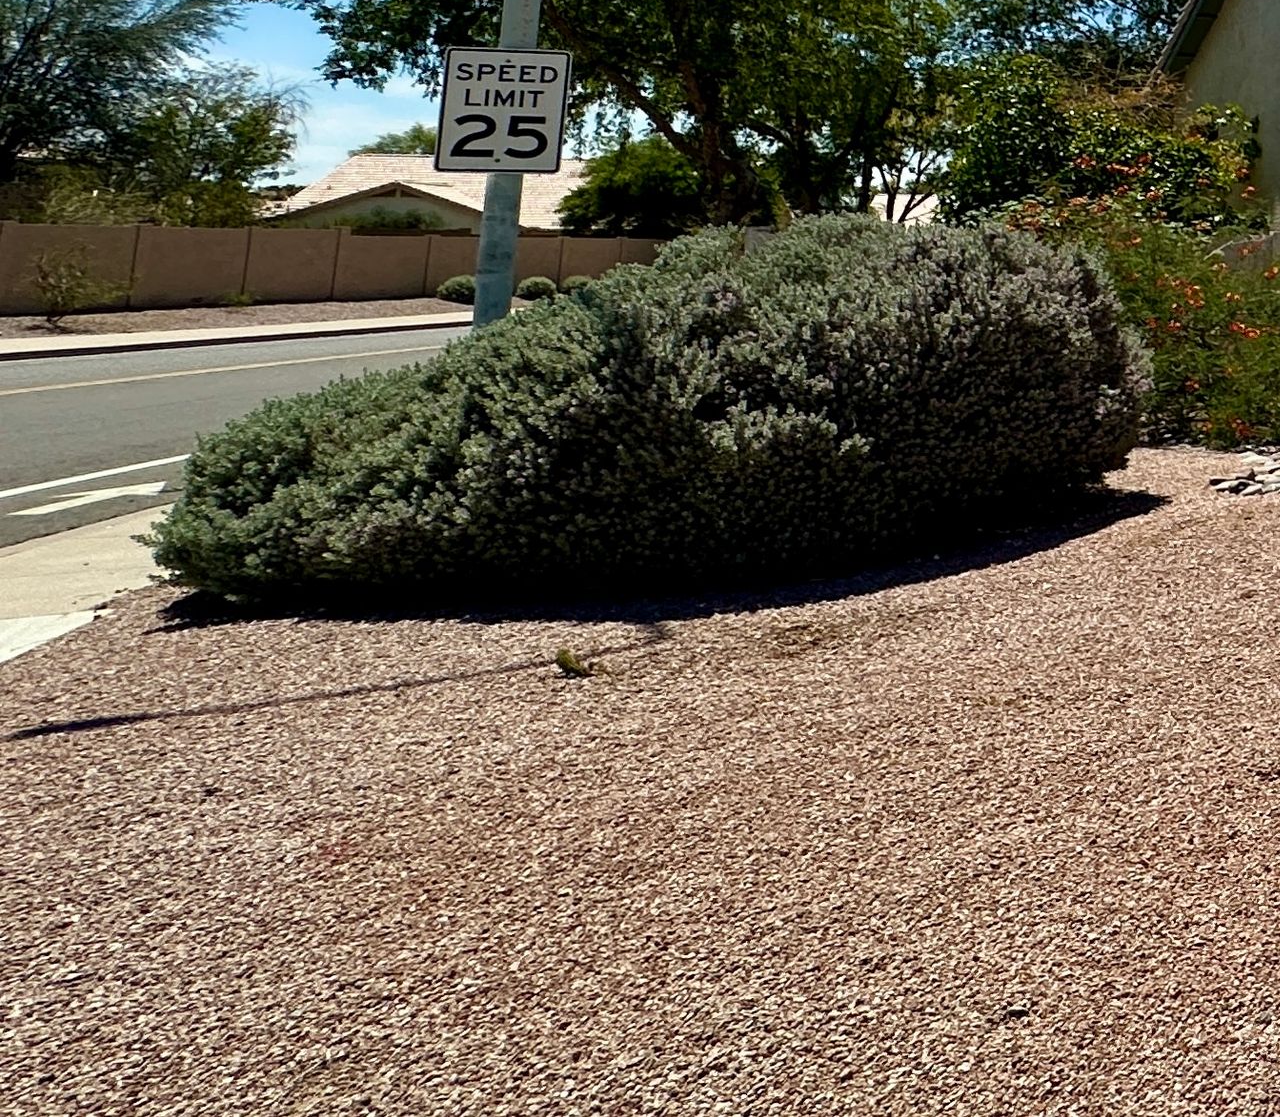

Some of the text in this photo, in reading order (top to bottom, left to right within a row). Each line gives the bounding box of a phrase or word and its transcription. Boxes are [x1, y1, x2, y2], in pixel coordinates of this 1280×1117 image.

[456, 63, 559, 84] SPEED
[464, 88, 545, 108] LIMIT
[450, 113, 548, 159] 25
